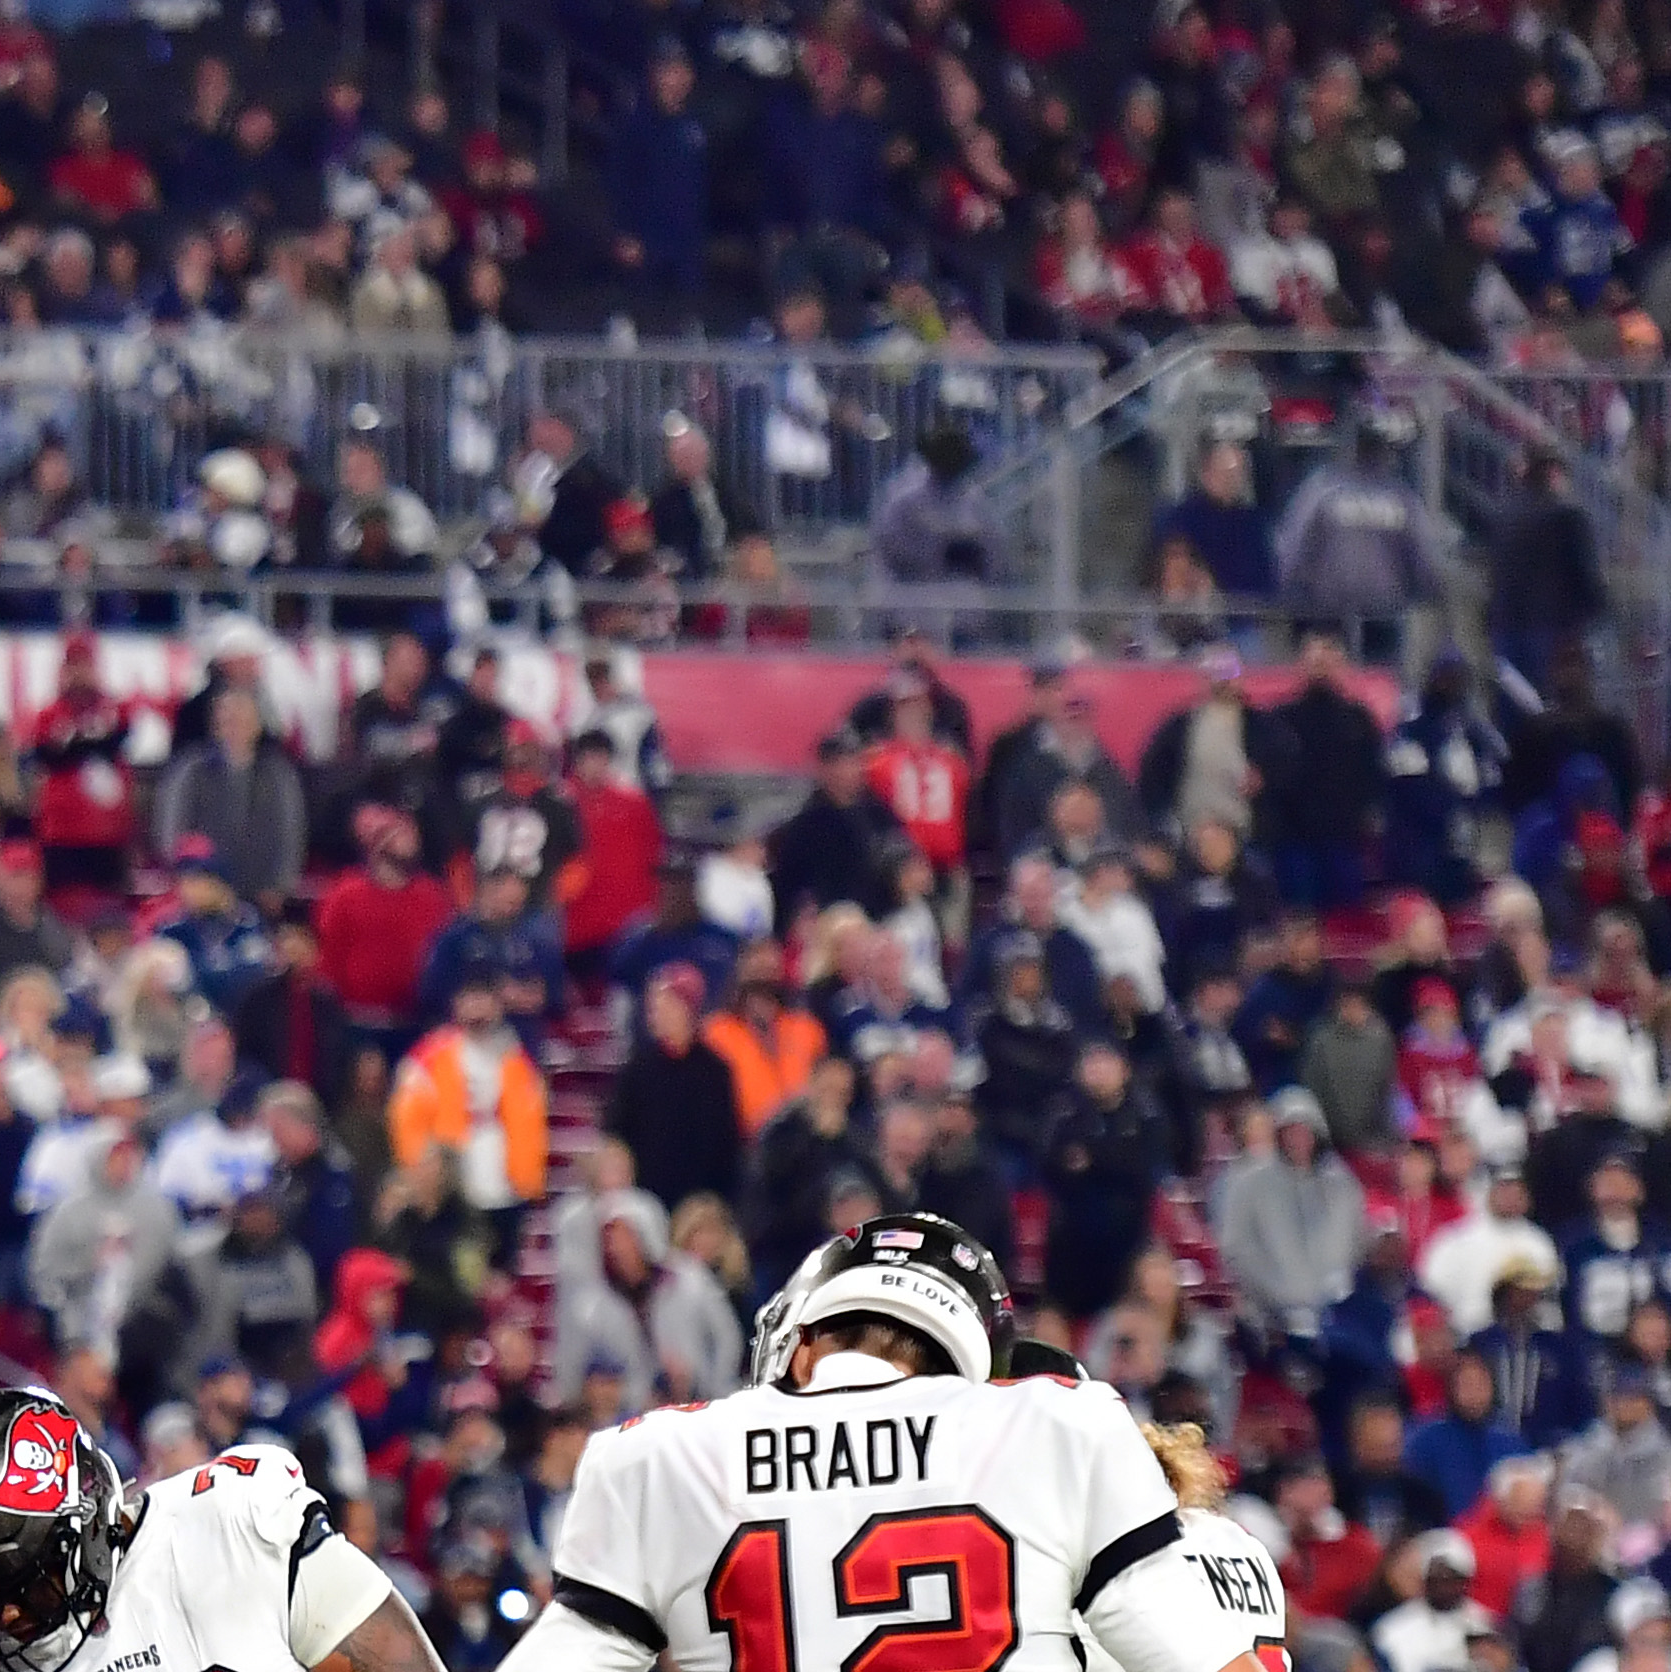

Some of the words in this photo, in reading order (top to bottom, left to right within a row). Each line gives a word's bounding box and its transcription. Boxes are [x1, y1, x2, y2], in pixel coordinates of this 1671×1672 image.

[881, 1274, 907, 1287] BE
[913, 1281, 961, 1316] LOVE
[745, 1415, 938, 1495] BRADY
